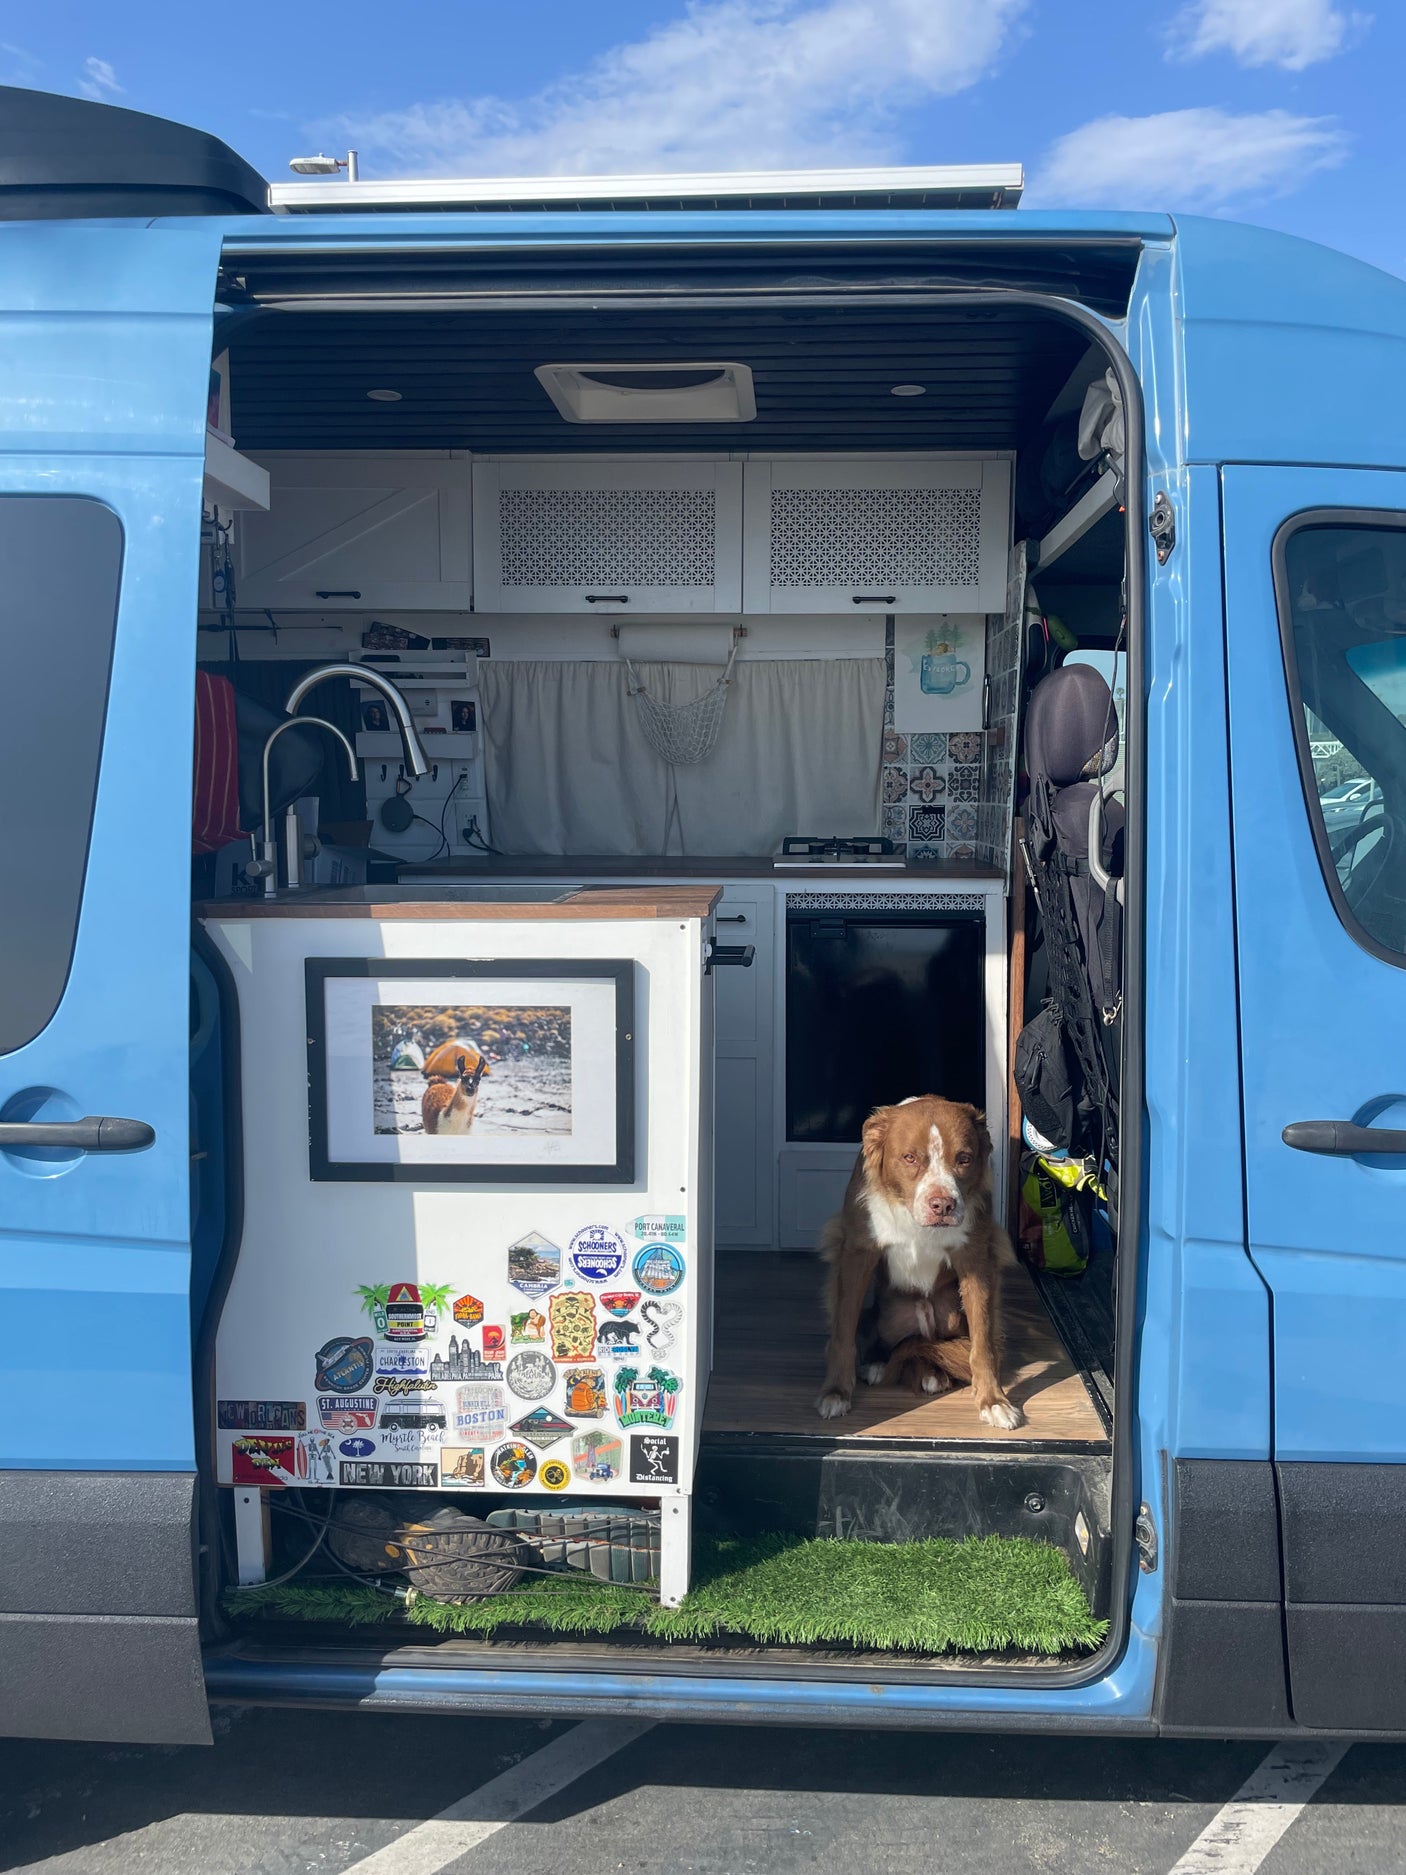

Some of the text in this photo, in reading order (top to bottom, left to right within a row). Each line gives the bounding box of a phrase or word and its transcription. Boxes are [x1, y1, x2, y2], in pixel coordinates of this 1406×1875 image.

[634, 1222, 685, 1232] PORT CANAVERAL
[577, 1240, 617, 1253] SCHOONERS
[577, 1255, 618, 1269] SCHOONERS
[377, 1317, 385, 1328] 0
[379, 1356, 425, 1367] CHARLESTON
[374, 1377, 437, 1396] Highfalutin
[321, 1398, 374, 1410] ST. AUGUSTINE
[456, 1409, 505, 1426] BOSTON
[619, 1410, 672, 1428] MONTEREY
[381, 1430, 446, 1447] Myrtle Beach
[643, 1437, 667, 1445] Social
[343, 1463, 435, 1486] NEW YORK
[636, 1473, 673, 1483] Distancing
